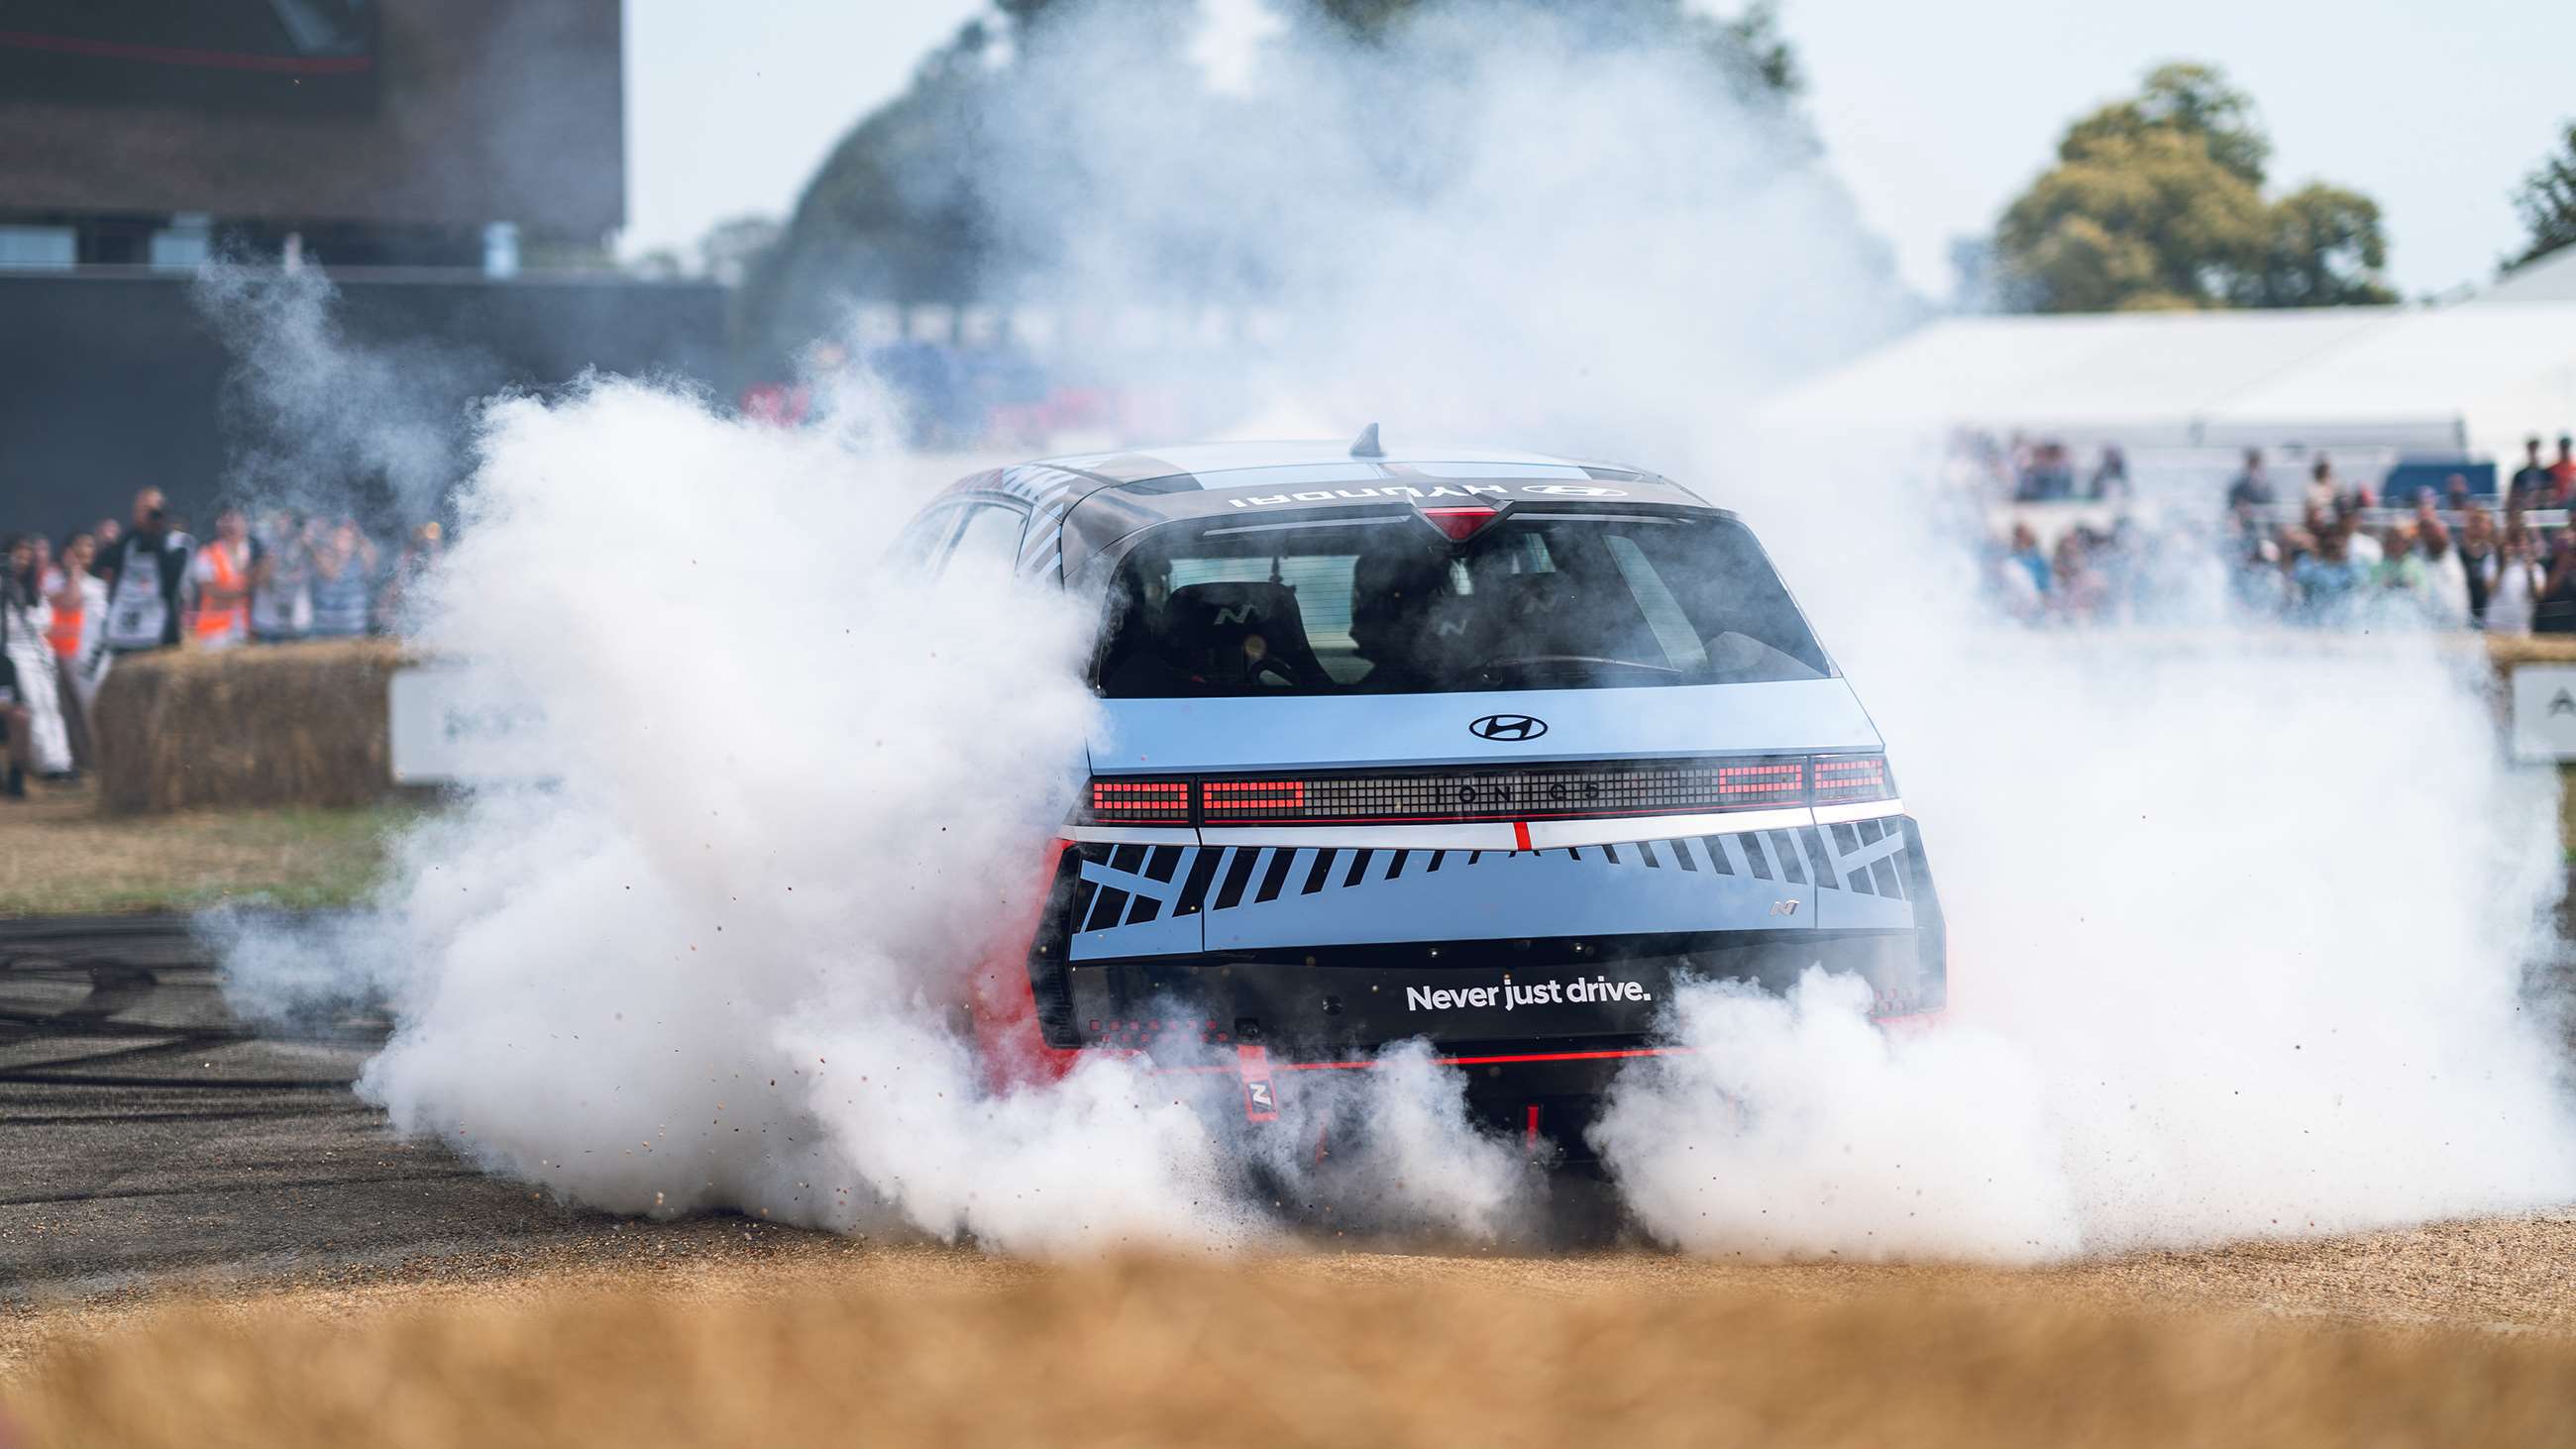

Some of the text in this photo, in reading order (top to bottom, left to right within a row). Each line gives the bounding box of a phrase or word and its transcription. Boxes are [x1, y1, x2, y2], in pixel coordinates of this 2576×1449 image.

[1228, 484, 1509, 508] HYUNDAI
[1585, 781, 1600, 800] 5
[1406, 976, 1653, 1011] Never just drive.
